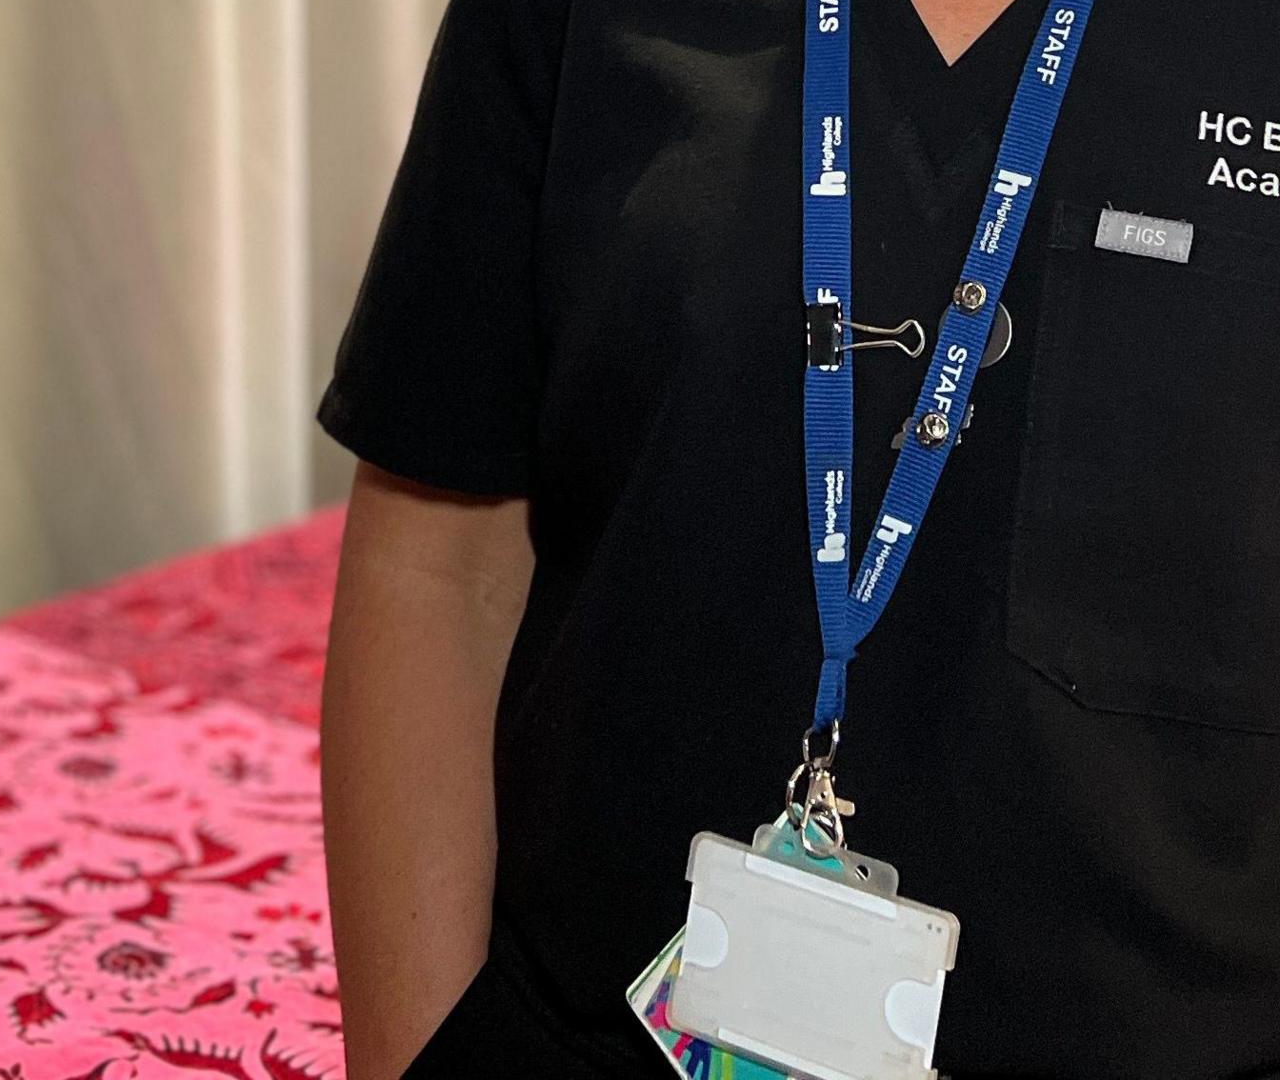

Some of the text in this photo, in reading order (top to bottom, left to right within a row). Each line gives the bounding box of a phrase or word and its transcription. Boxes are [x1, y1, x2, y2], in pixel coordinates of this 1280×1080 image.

[1036, 8, 1075, 86] STAFF
[822, 116, 835, 171] Highlands
[1197, 110, 1253, 147] HC
[986, 196, 1013, 254] Highlands
[1123, 224, 1167, 247] FIGS
[933, 344, 968, 419] STAF
[861, 544, 892, 603] Highlands
